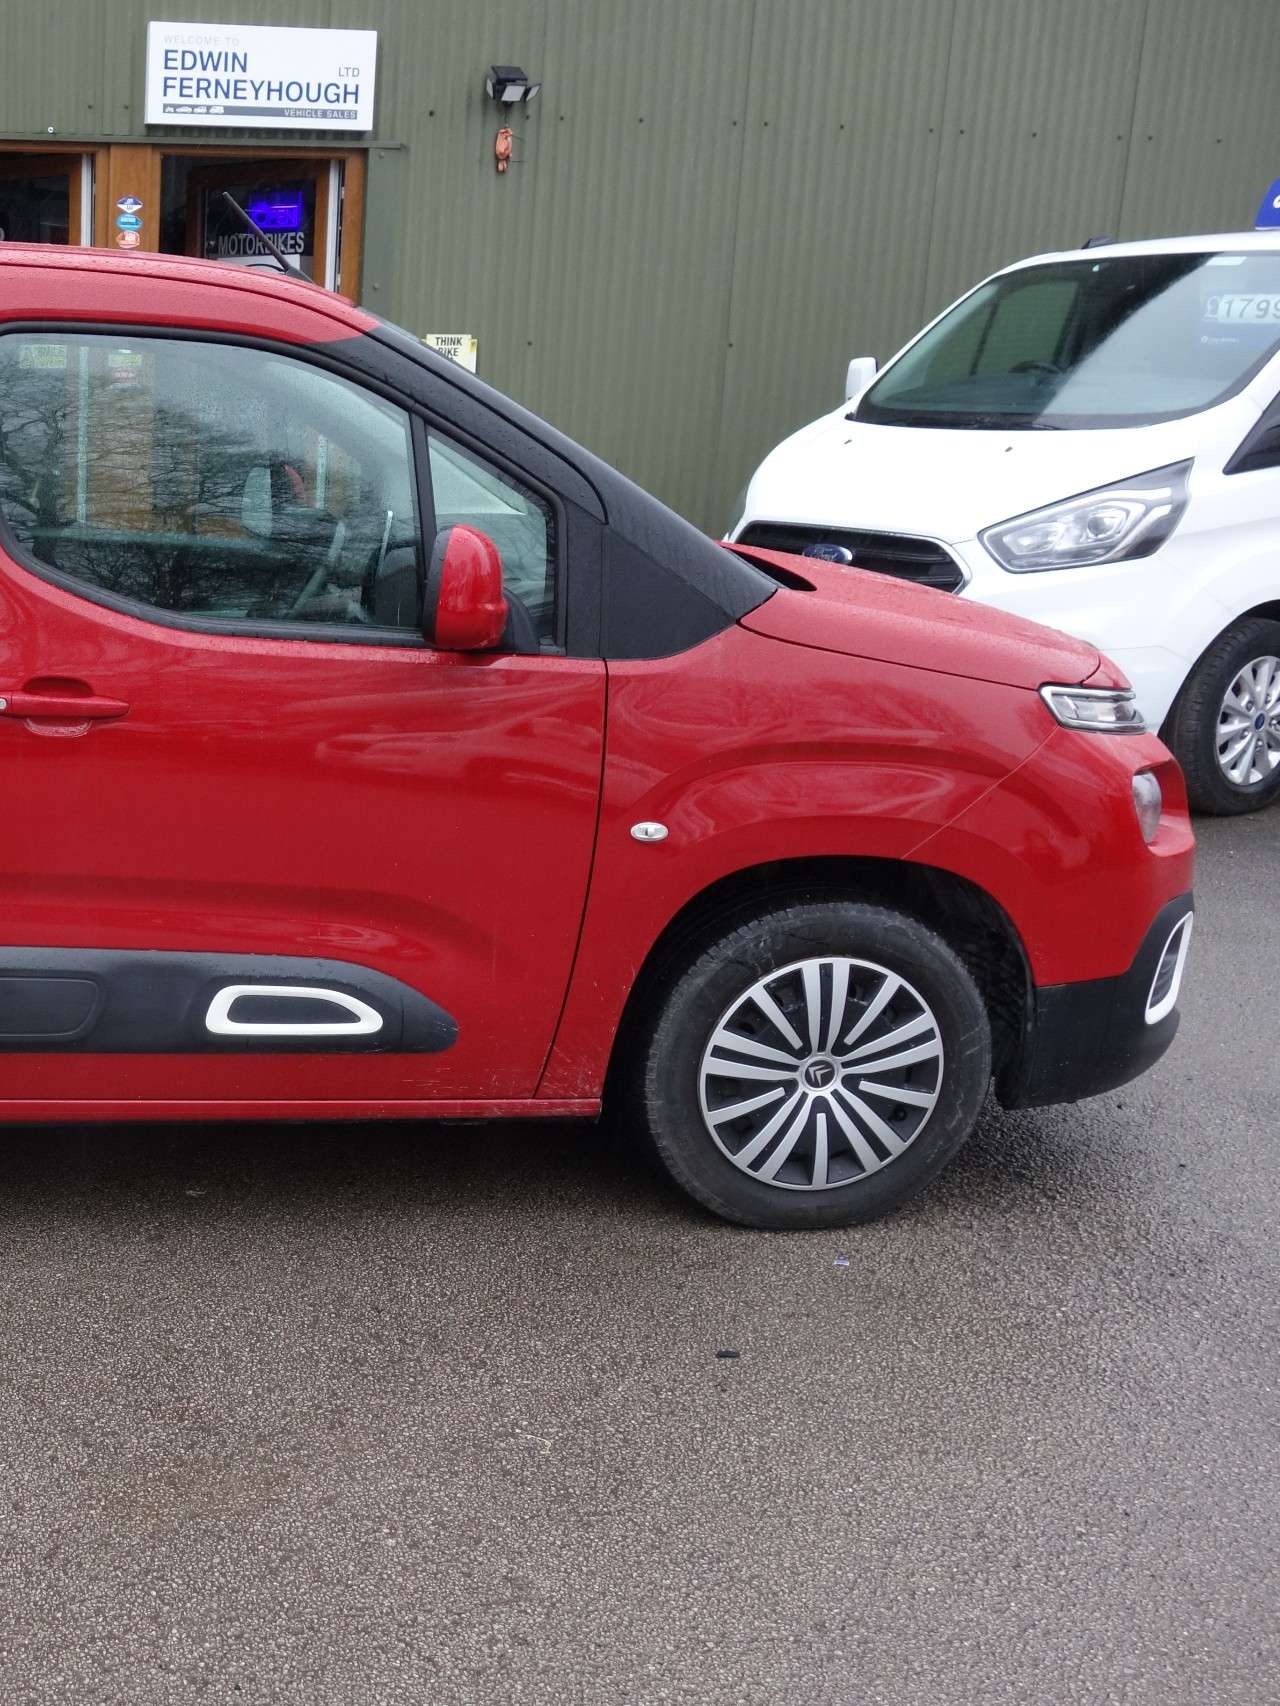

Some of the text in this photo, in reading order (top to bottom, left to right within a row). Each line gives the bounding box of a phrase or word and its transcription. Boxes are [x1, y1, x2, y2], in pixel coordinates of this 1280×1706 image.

[163, 35, 240, 47] WELCOME TO
[163, 48, 248, 73] EDWIN
[338, 66, 360, 78] LTD
[162, 76, 359, 104] FERNEYHOUGH
[283, 109, 356, 120] VEHICLE SALES
[218, 232, 305, 254] MOTORBIKES
[435, 336, 463, 346] THINK
